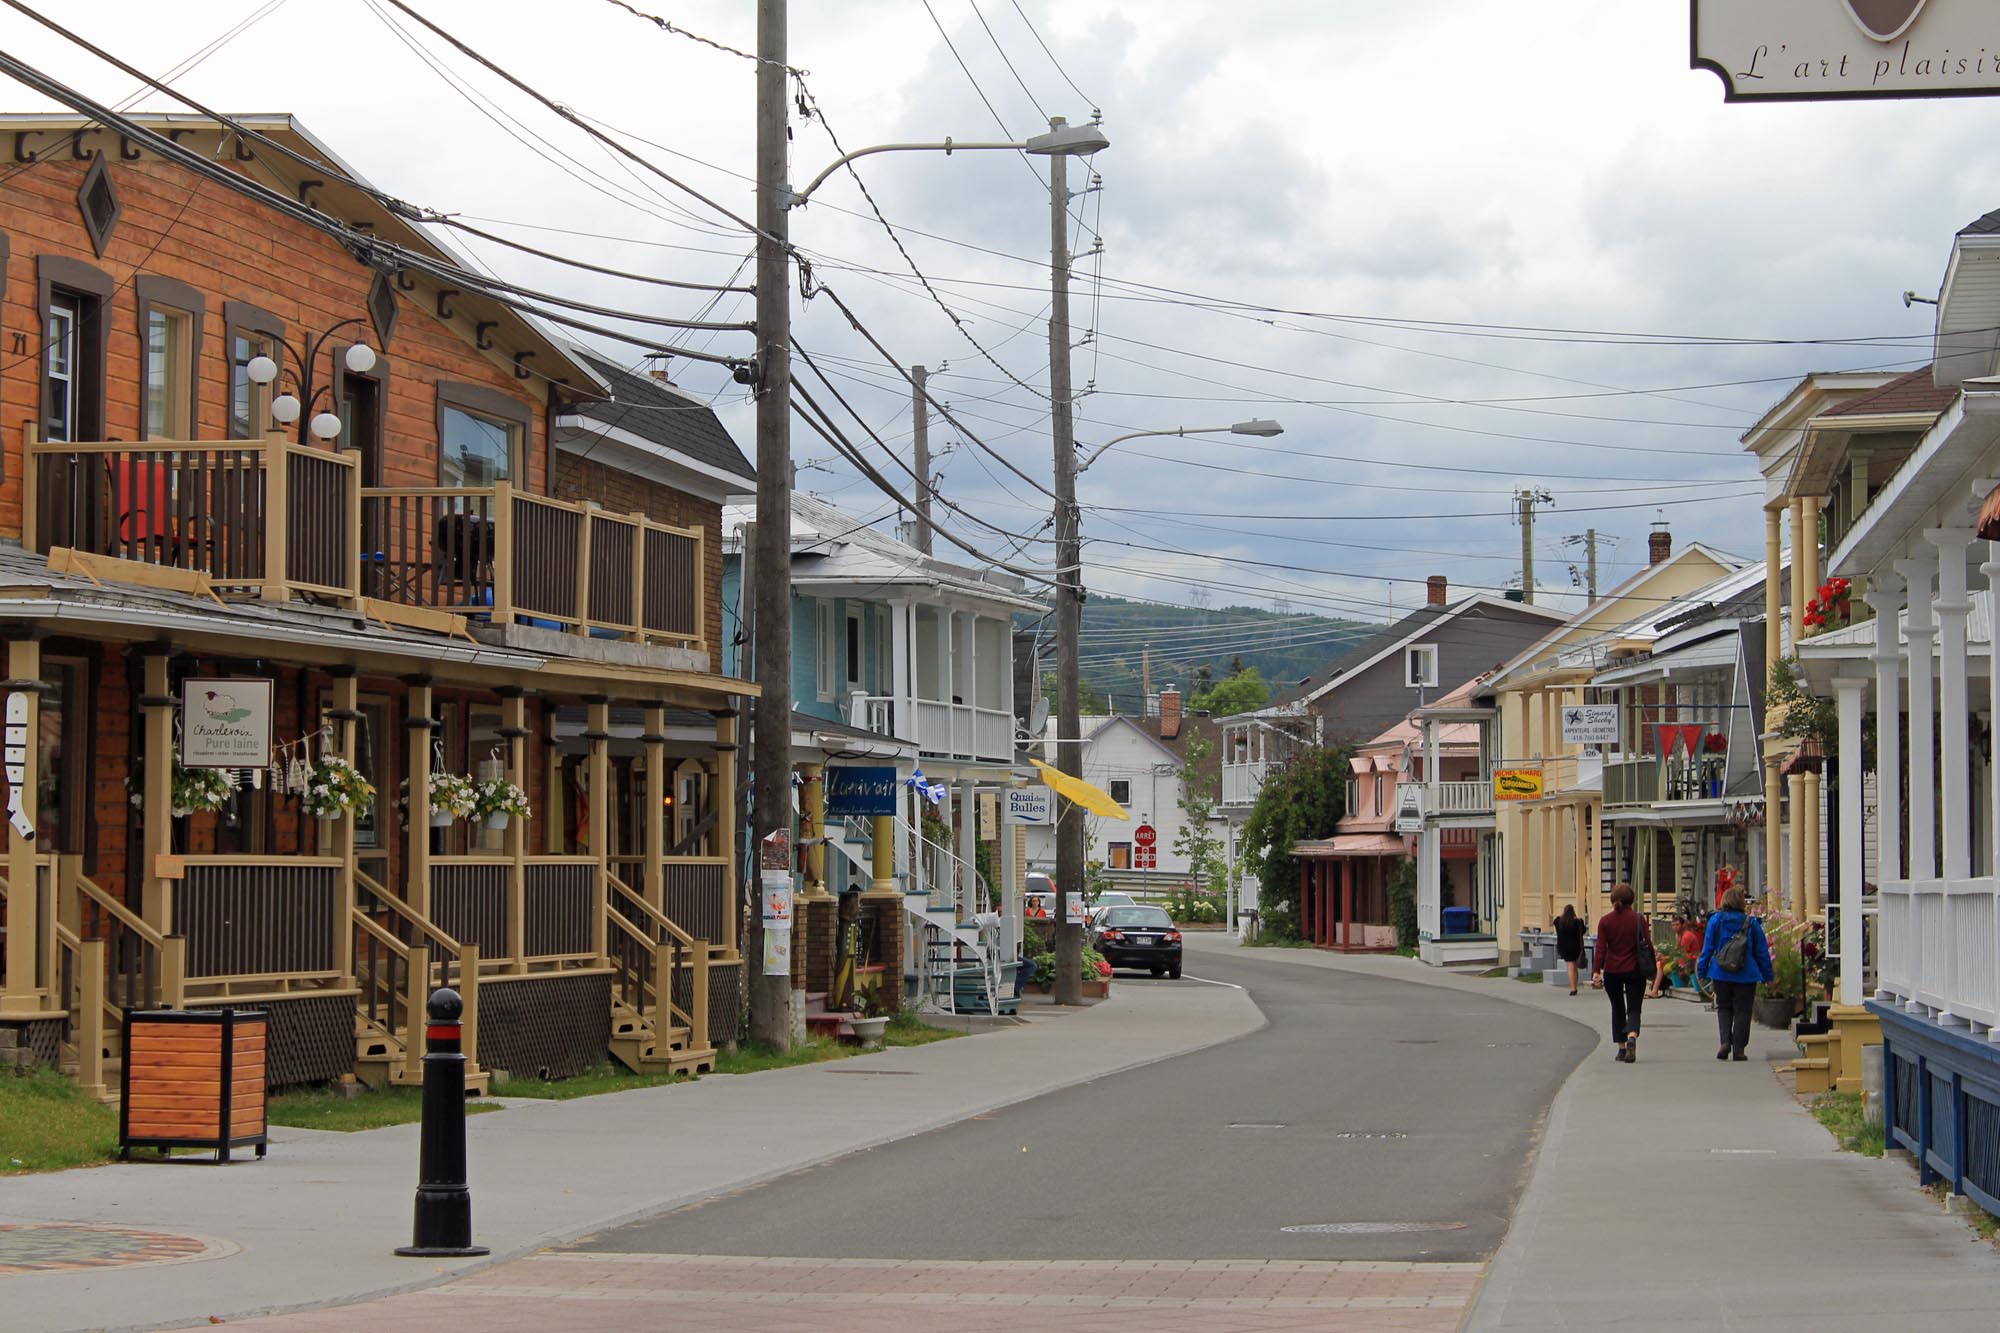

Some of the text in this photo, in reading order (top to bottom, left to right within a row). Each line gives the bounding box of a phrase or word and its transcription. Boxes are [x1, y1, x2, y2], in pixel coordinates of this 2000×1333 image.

[1736, 45, 1848, 79] L'art
[13, 332, 26, 355] 71
[193, 723, 253, 737] Charlevoix
[206, 738, 259, 749] Pure laine
[1010, 792, 1034, 801] Quai
[1010, 802, 1046, 812] Bulles
[1136, 830, 1155, 840] ARRÊT
